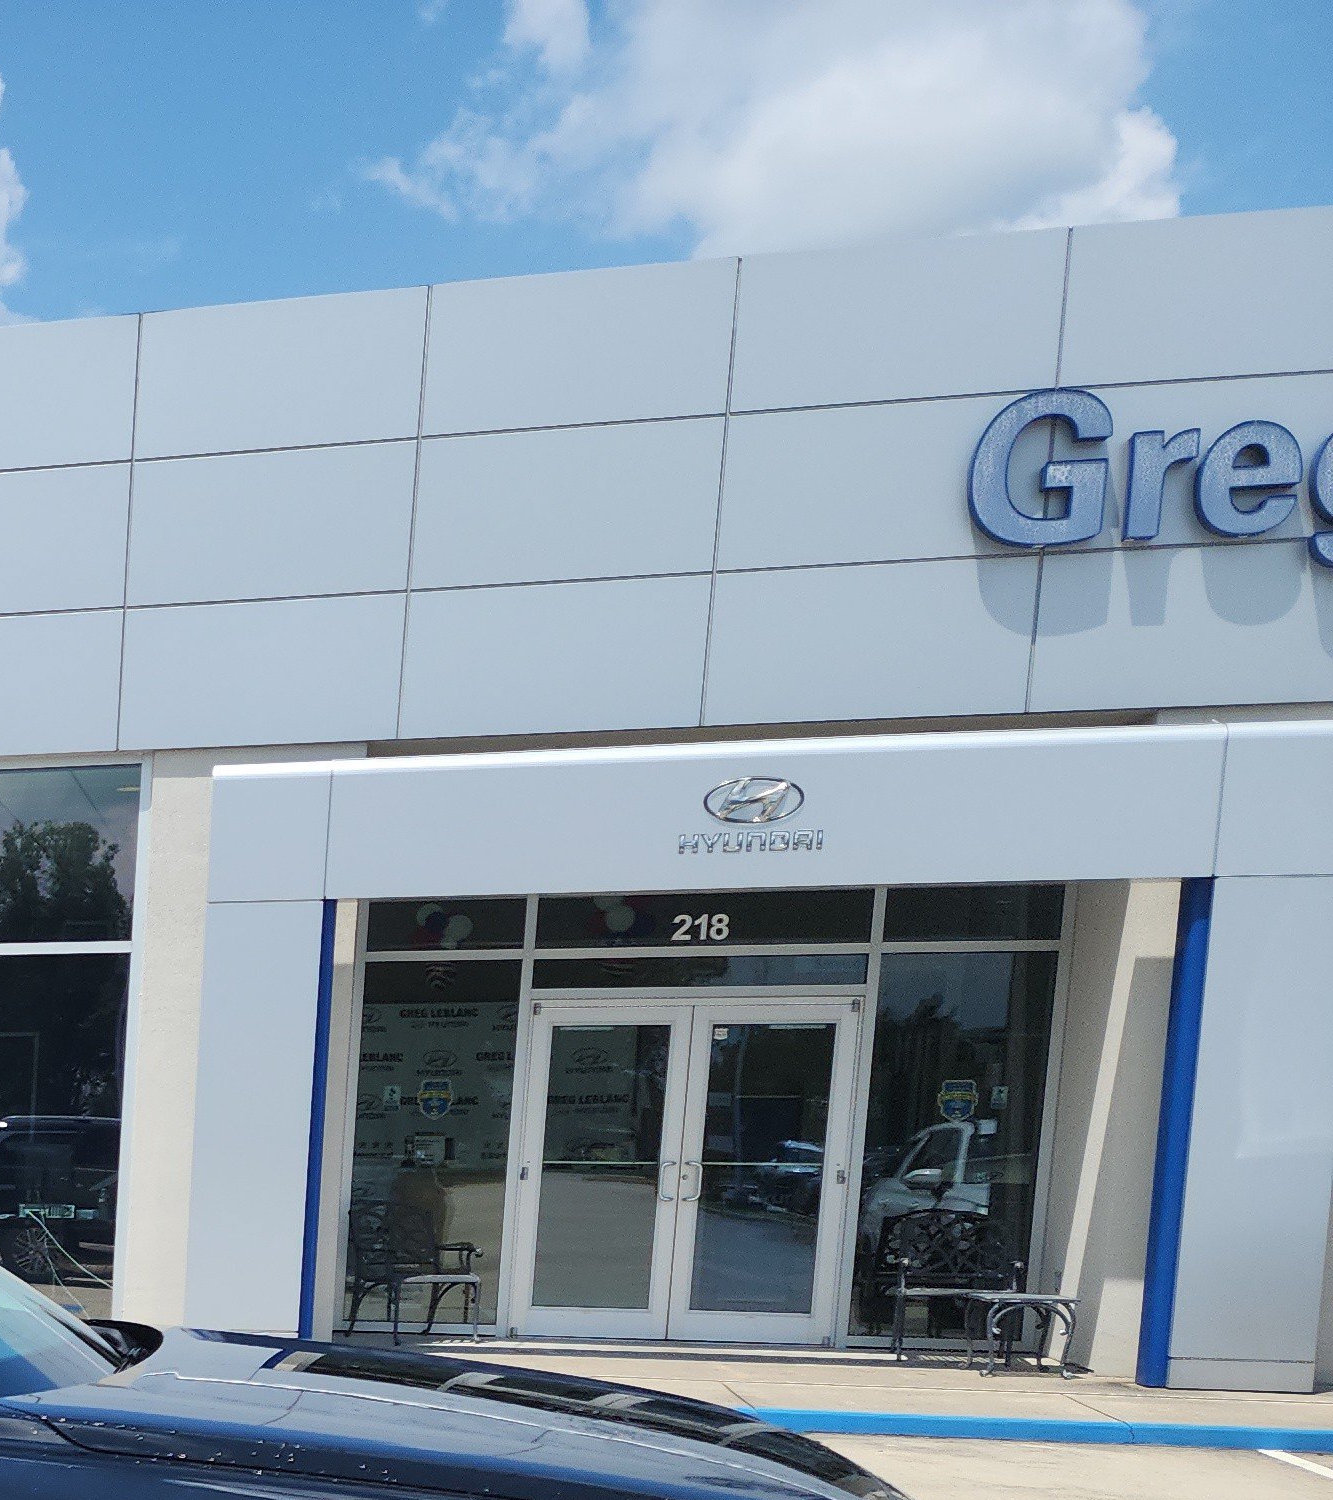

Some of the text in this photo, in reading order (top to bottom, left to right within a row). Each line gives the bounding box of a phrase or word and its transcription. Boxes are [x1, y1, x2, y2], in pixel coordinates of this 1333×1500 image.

[968, 388, 1333, 568] Gre
[678, 829, 824, 855] HYUNDAI
[670, 913, 730, 941] 218
